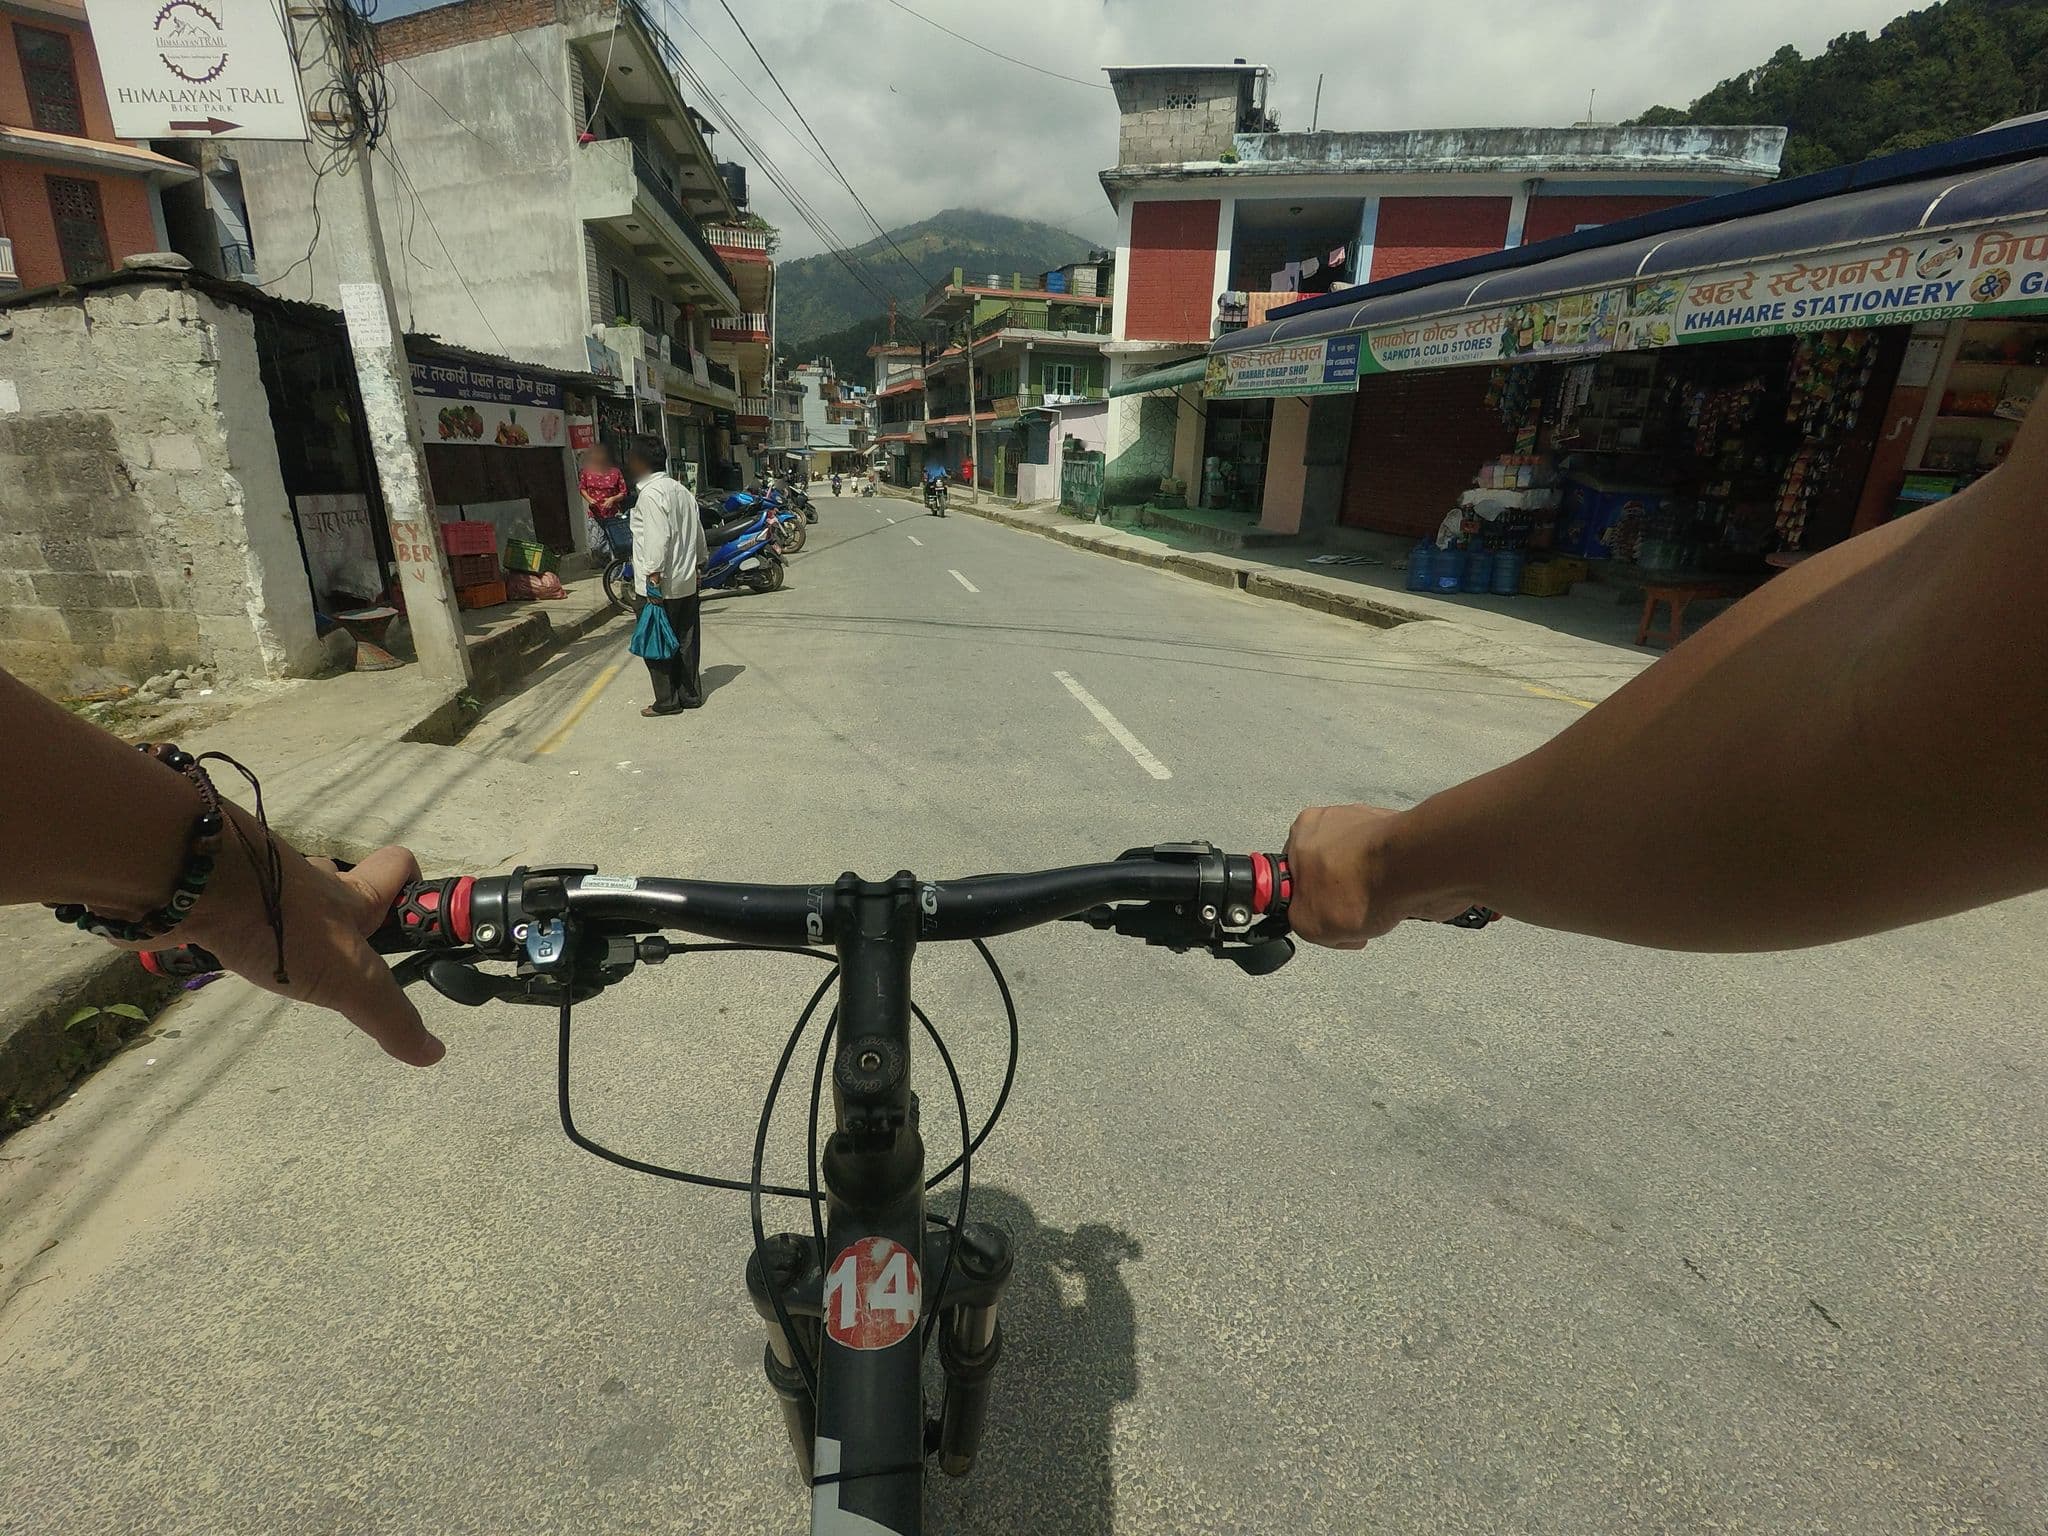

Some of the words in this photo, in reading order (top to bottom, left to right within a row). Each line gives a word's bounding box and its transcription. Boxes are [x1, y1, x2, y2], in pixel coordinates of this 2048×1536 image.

[226, 87, 284, 104] TRAIL
[171, 104, 199, 112] BIKE
[204, 104, 234, 113] PARK
[1688, 271, 1760, 306] खहरे
[1684, 302, 1786, 331] KHAHARE
[1791, 279, 1965, 319] STATIONERY
[1875, 305, 1975, 327] 9856038222
[1382, 346, 1421, 362] SAPKOTA
[1423, 343, 1449, 356] COLD
[1451, 337, 1493, 353] STORES
[1266, 367, 1288, 377] CHEAP
[1288, 364, 1309, 375] SHOP
[398, 544, 433, 563] BER
[826, 1252, 922, 1330] 14
